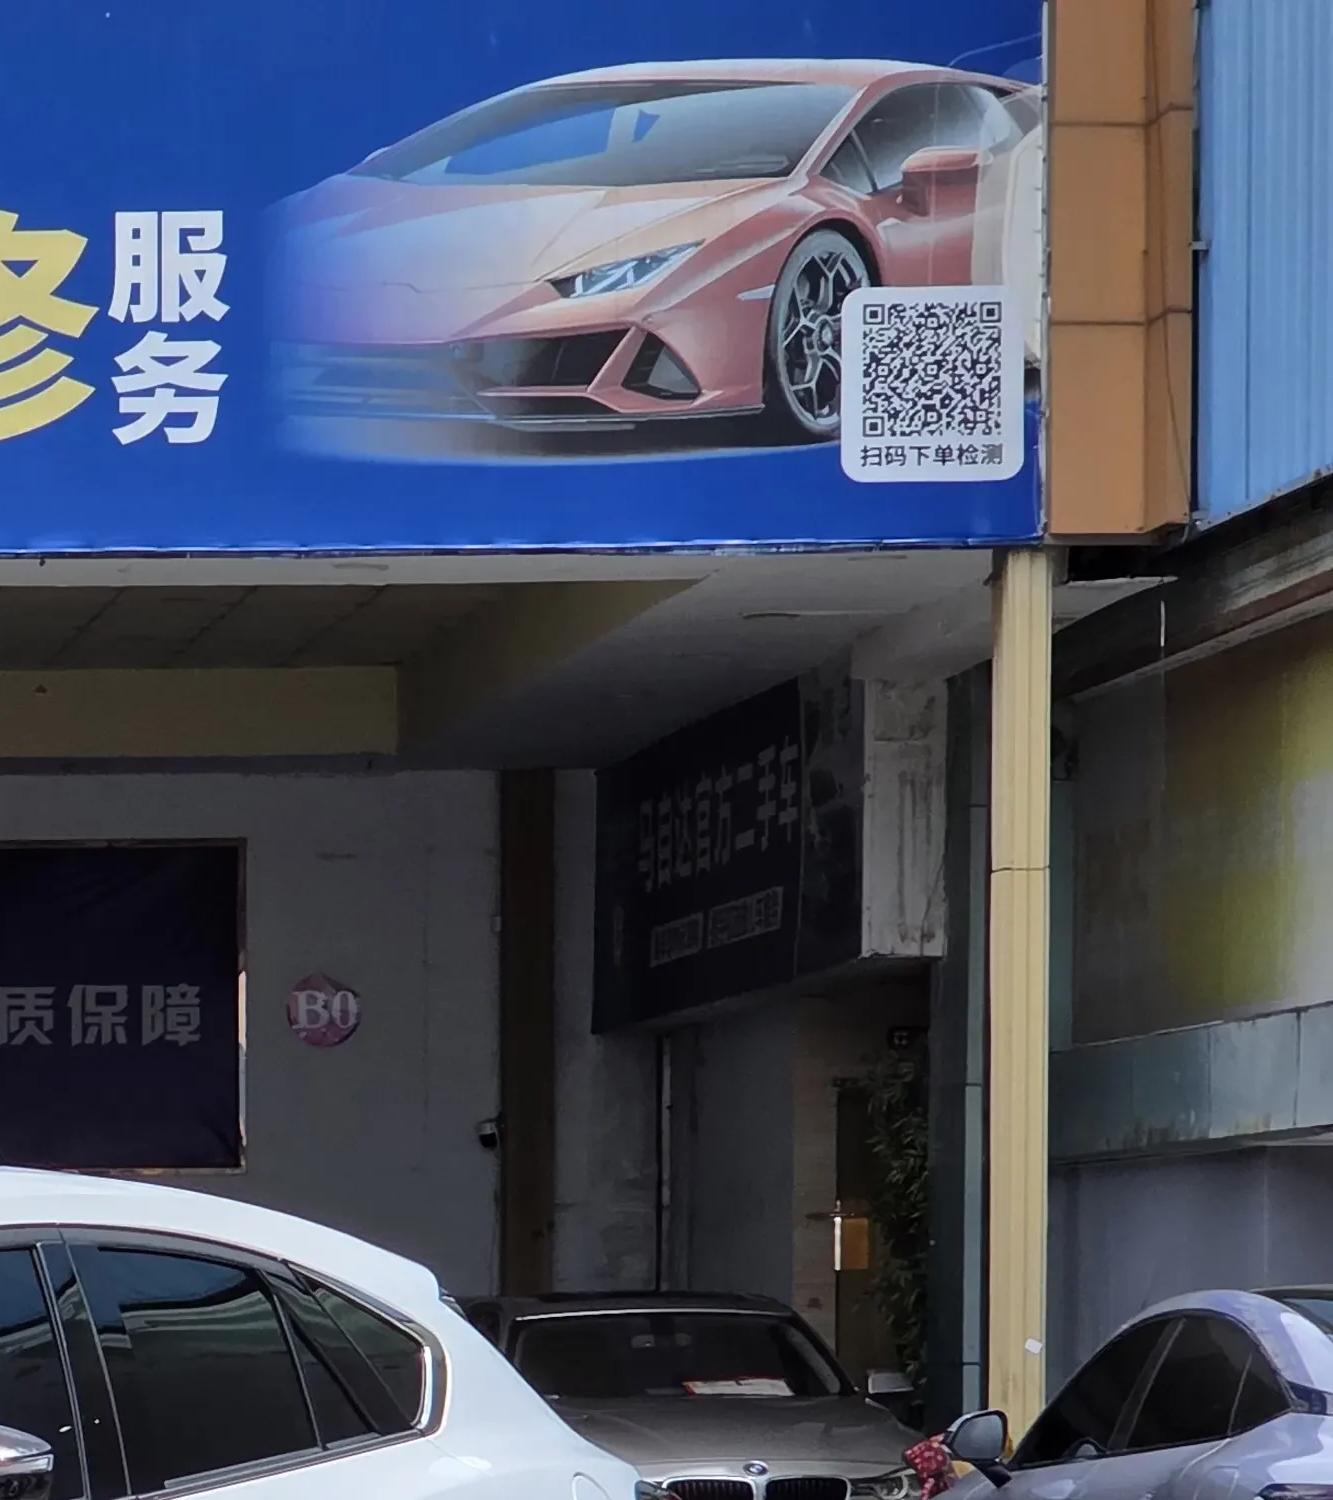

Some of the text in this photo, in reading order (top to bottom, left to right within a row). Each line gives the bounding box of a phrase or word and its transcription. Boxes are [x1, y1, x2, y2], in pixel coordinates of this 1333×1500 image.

[107, 209, 231, 447] 服务
[859, 443, 1004, 468] 扫码下单检测
